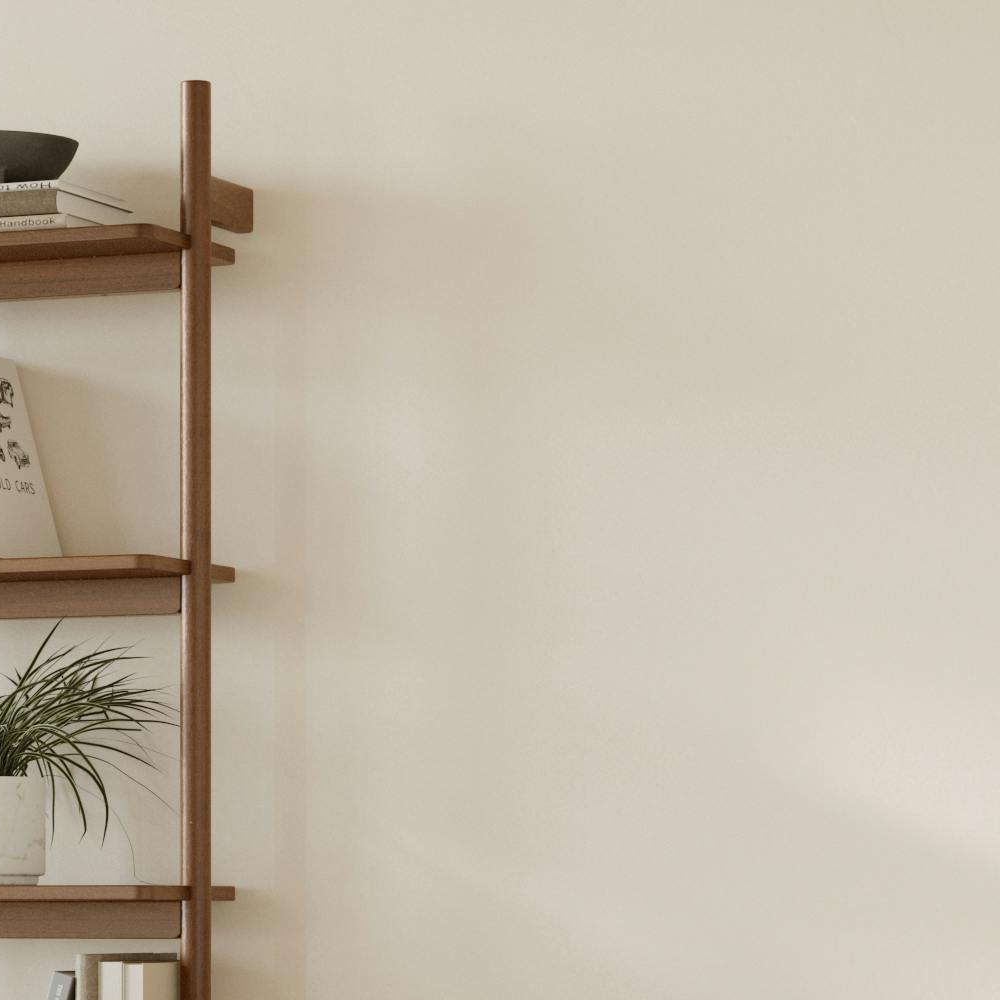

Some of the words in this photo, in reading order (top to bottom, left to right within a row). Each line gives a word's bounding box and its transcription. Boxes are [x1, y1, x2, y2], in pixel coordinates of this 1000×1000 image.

[16, 181, 51, 190] How
[0, 217, 57, 228] Handbook
[14, 480, 36, 495] CARS
